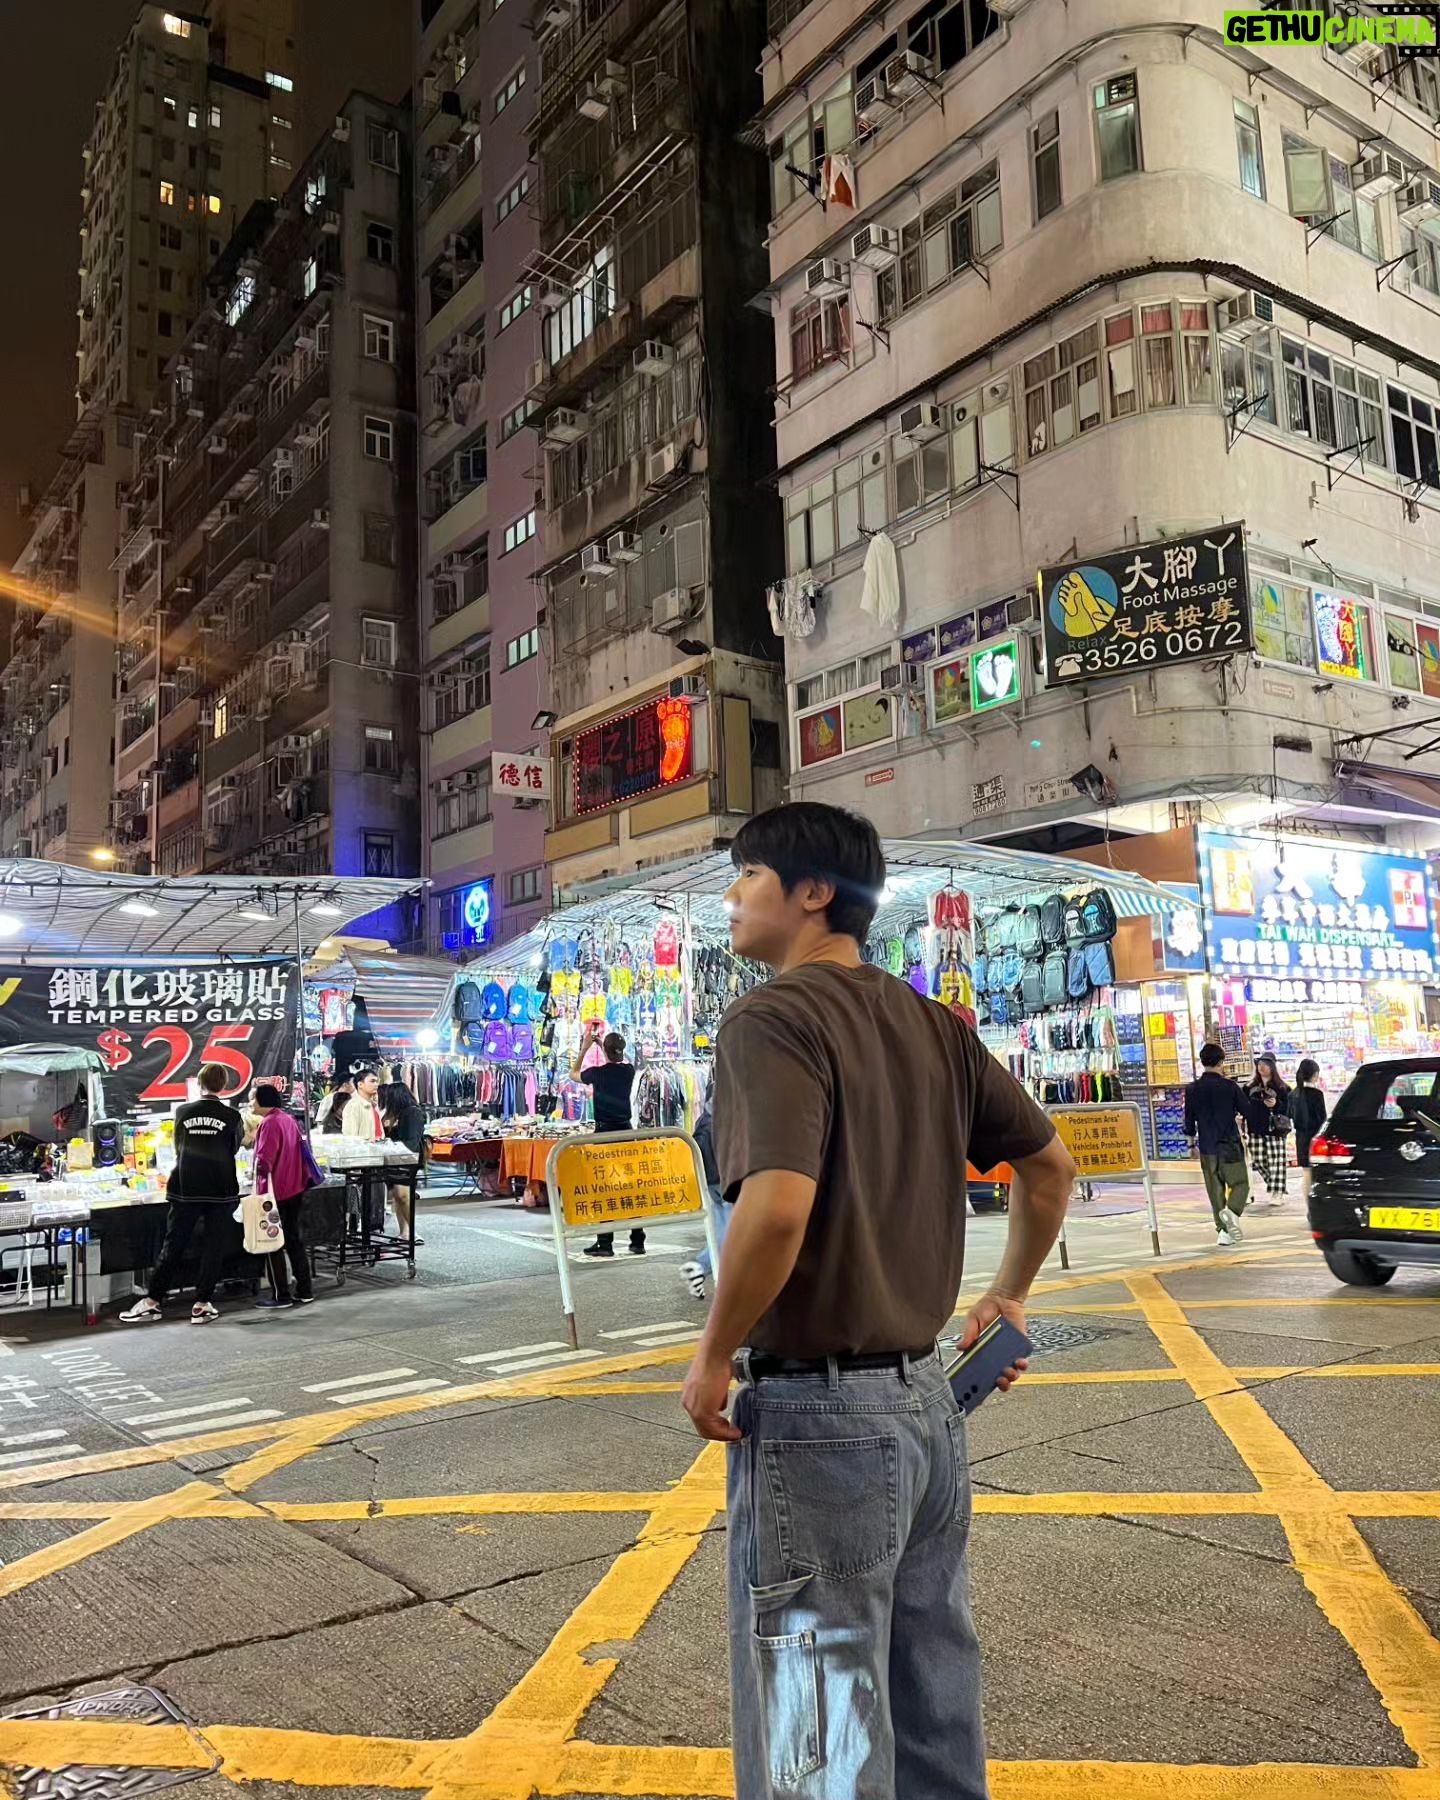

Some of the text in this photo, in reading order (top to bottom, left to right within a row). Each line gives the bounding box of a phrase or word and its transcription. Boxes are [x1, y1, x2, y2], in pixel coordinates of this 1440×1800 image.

[1121, 532, 1236, 594] 大腳丫
[1122, 577, 1238, 611] Foot Massage
[1109, 596, 1240, 642] 足底按摩
[1067, 634, 1108, 652] Relax
[1085, 621, 1244, 672] 3526 0672
[499, 762, 543, 789] 德信
[1258, 923, 1395, 947] TAI WAH DISPENSARY
[48, 967, 290, 1008] 鋼化玻璃貼
[48, 1007, 285, 1024] TEMPERED GLASS
[96, 1025, 254, 1102] $25
[574, 1175, 686, 1196] All Vehicles Prohibited
[593, 1159, 664, 1180] 行人專用區
[575, 1190, 690, 1216] 所有車輛禁止駛入
[40, 1347, 127, 1384] LOOK
[73, 1379, 165, 1411] LEFT
